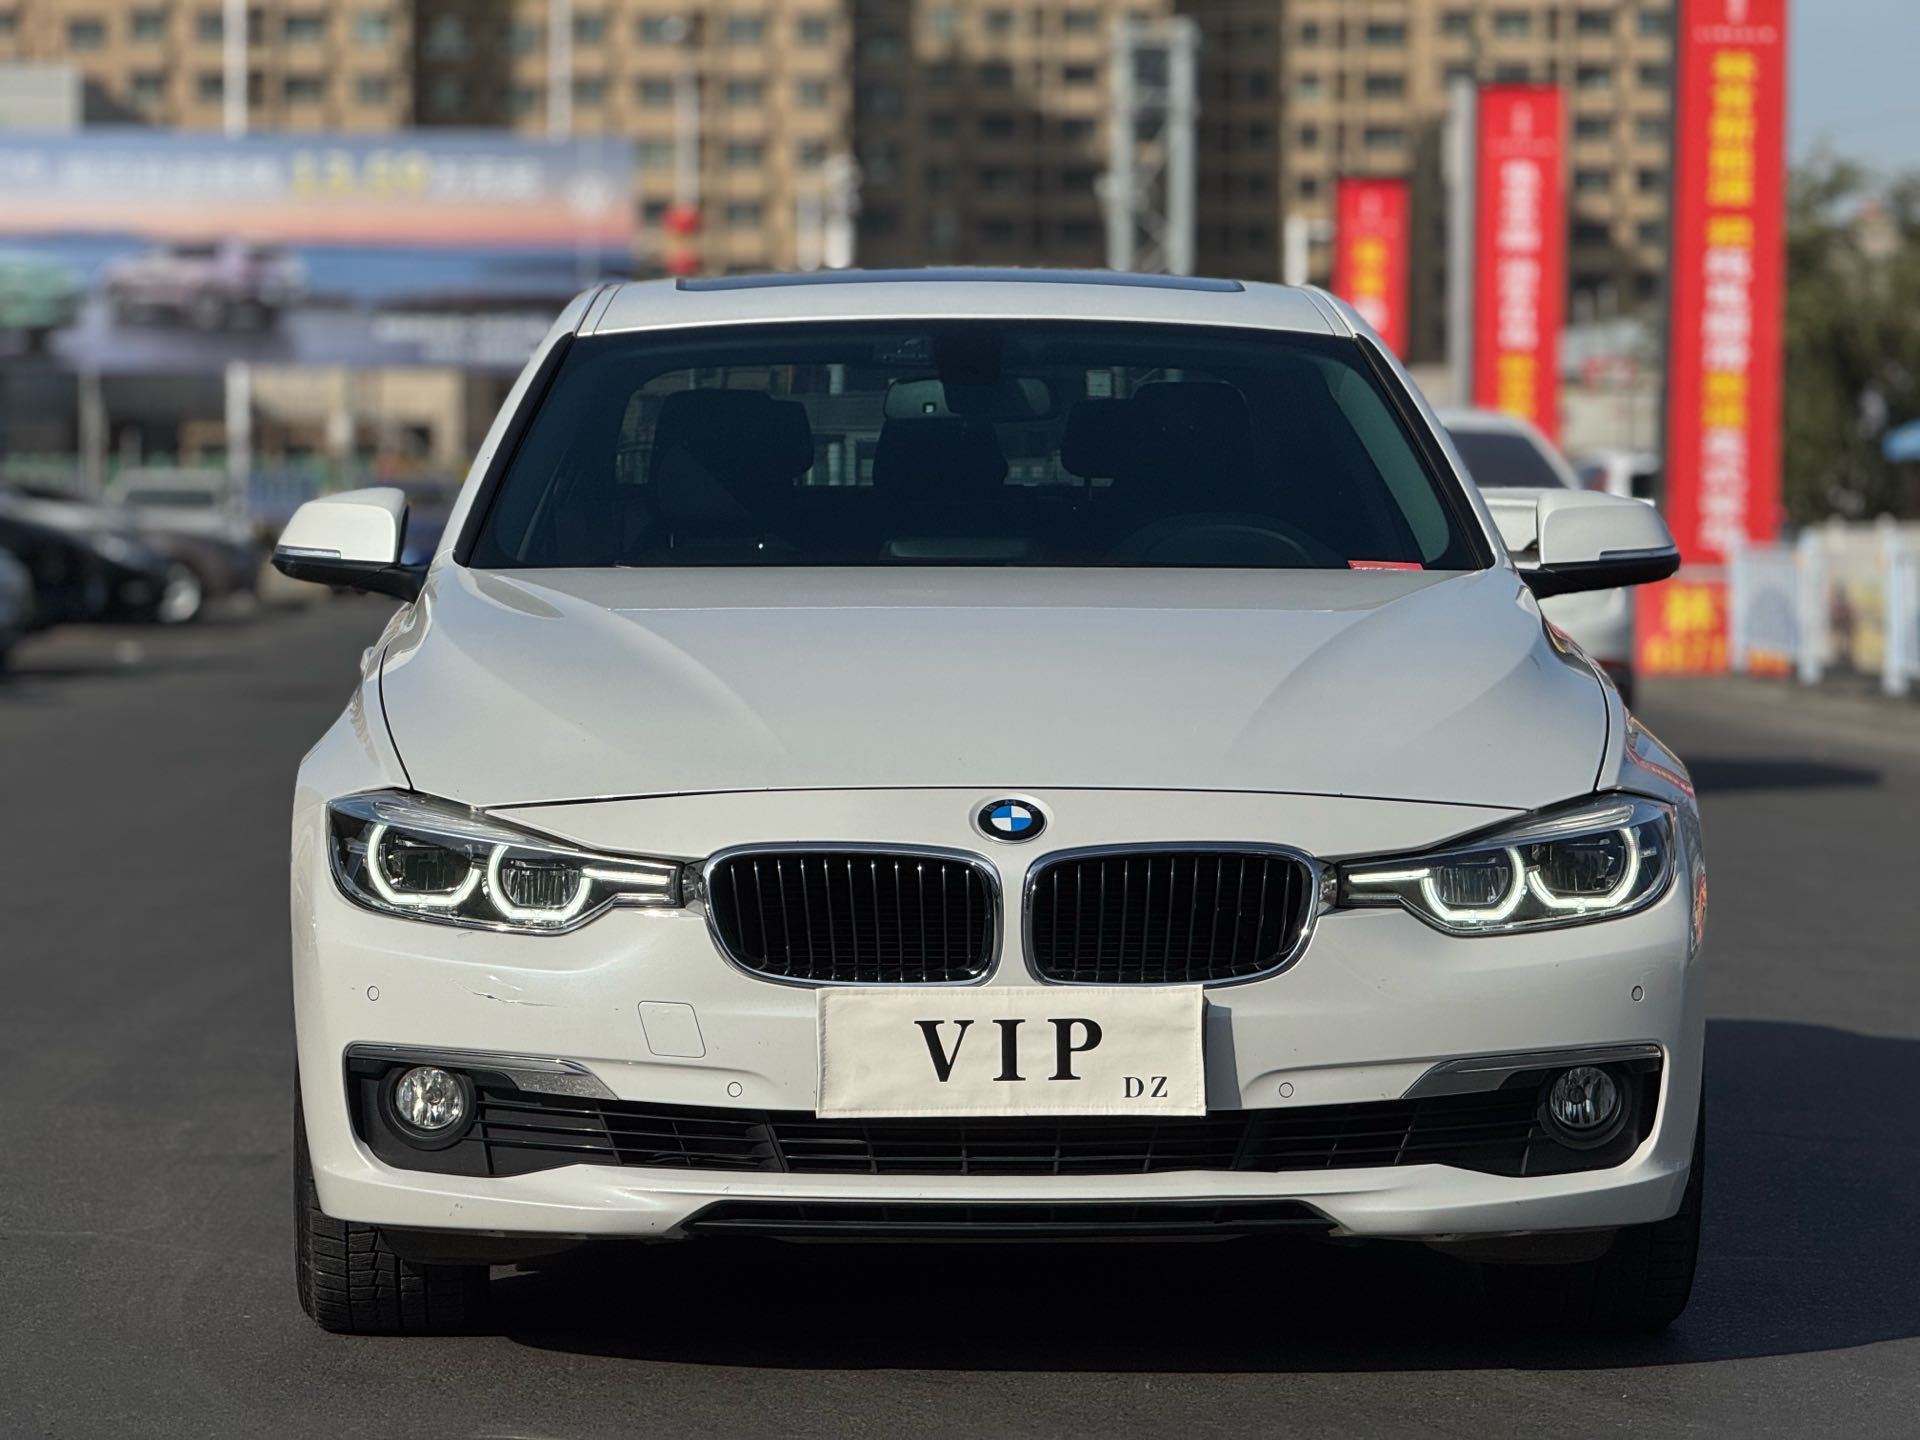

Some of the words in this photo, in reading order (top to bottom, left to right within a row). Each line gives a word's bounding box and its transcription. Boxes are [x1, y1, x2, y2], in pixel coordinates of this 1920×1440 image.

[984, 800, 1038, 812] BMW
[914, 1018, 1103, 1082] VIP
[1122, 1076, 1168, 1098] DZ
